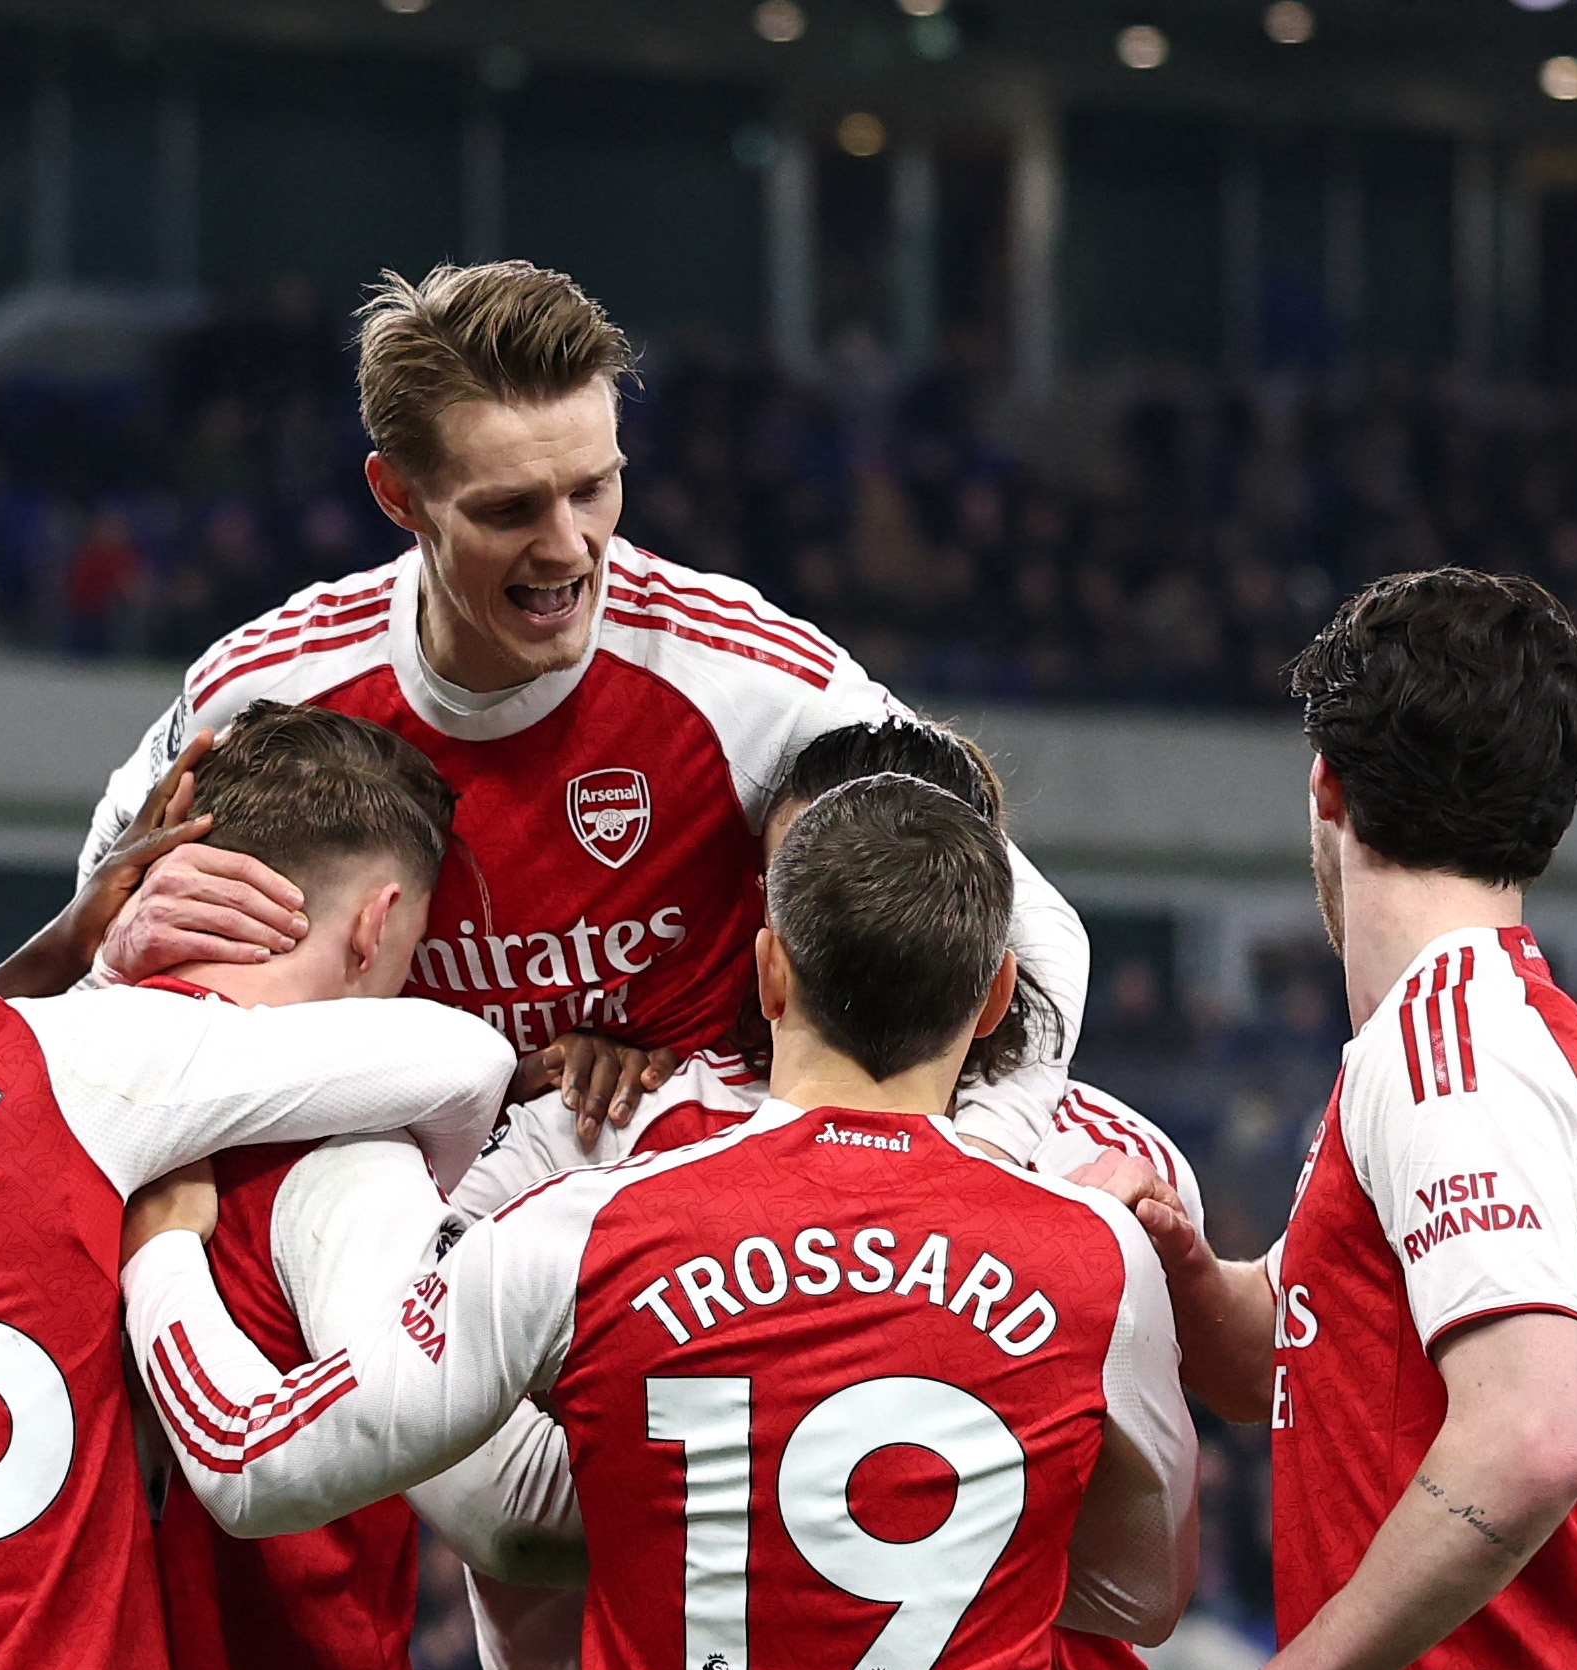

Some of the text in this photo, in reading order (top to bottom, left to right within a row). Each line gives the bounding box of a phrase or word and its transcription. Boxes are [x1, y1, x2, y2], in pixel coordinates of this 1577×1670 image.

[579, 783, 639, 805] Arsenal
[408, 906, 686, 992] mirates
[815, 1121, 911, 1154] Arsenal
[1415, 1171, 1498, 1213] VISIT
[1403, 1203, 1543, 1265] RWANDA
[632, 1227, 1059, 1357] TROSSARD
[401, 1298, 447, 1365] NDA
